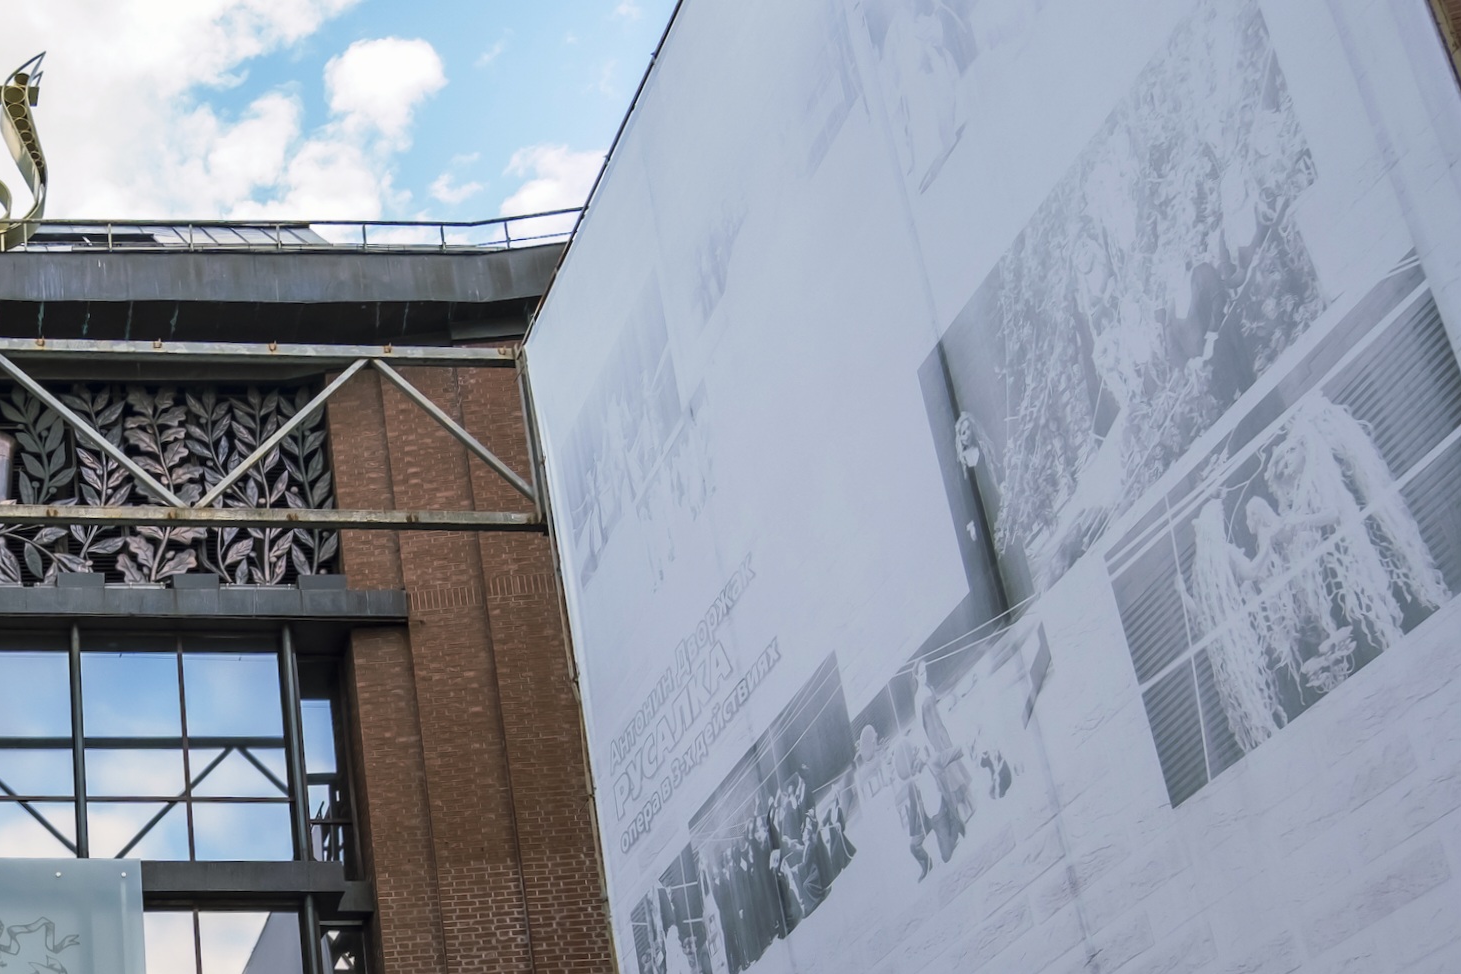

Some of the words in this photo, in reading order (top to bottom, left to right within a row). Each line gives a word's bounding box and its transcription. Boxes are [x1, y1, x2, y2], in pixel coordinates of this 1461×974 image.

[674, 551, 757, 681] Дворжак
[612, 640, 734, 821] РУСАЛКА
[619, 790, 662, 854] опера
[660, 775, 673, 804] в
[671, 756, 695, 791] 3-х
[692, 635, 782, 768] действиях
